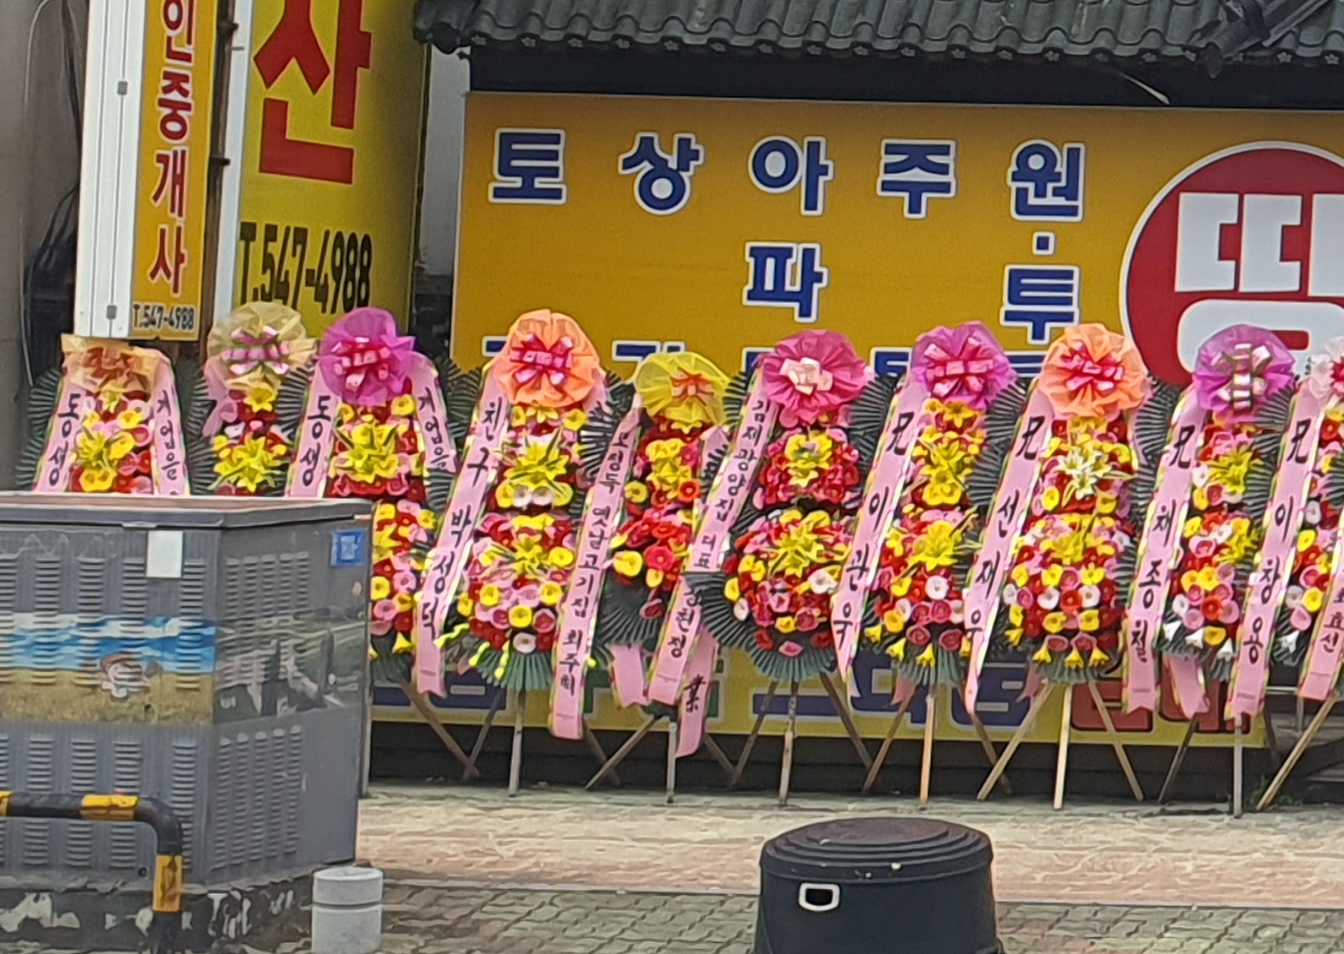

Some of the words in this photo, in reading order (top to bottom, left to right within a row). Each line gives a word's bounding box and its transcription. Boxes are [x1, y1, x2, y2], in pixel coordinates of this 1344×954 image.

[239, 221, 372, 314] T.547-4988
[131, 299, 196, 332] T.547-4988
[467, 396, 503, 487] 친구
